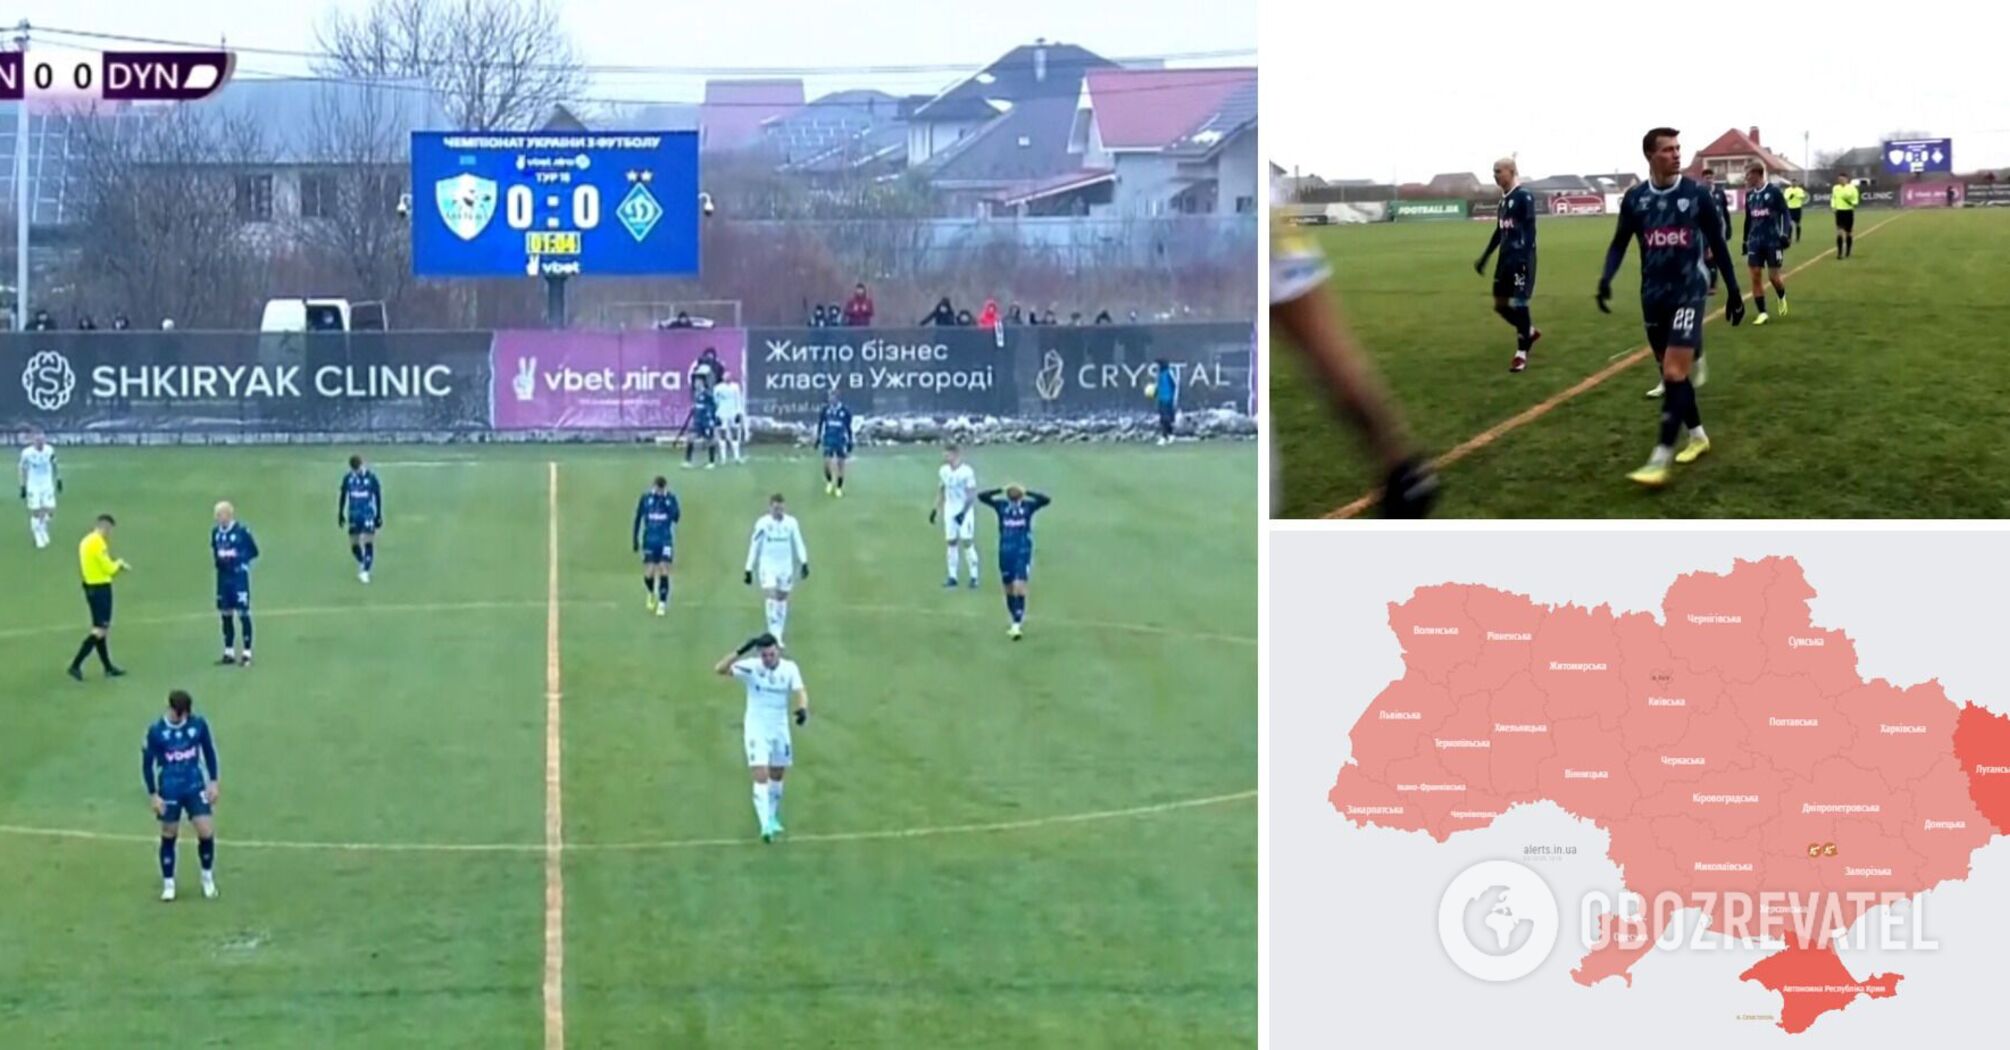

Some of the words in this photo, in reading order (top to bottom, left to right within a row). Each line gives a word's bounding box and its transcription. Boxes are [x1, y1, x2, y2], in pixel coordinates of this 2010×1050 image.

[443, 136, 524, 148] ЧЕМПІОНАТ
[595, 136, 661, 148] ФУТБОЛУ
[507, 184, 533, 229] 0
[573, 184, 599, 229] 0
[1645, 228, 1687, 246] vbet
[542, 261, 580, 273] vbet
[1673, 307, 1695, 330] 22
[765, 340, 854, 362] Житло
[861, 338, 949, 362] бізнес
[92, 364, 301, 397] SHKIRYAK
[315, 364, 452, 397] CLINIC
[544, 366, 615, 391] vbet
[622, 366, 681, 391] ліга
[765, 372, 842, 391] класу
[849, 373, 863, 389] в
[869, 365, 993, 393] Ужгороді
[1413, 625, 1459, 636] Волинська
[1486, 631, 1532, 642] Рівненська
[1788, 636, 1824, 648] Сумська
[1549, 661, 1607, 673] Житомирська
[1379, 710, 1422, 720] Львівська
[1769, 716, 1818, 727] Полтавська
[1880, 723, 1927, 735] Харківська
[1661, 755, 1706, 767] Черкаська
[1564, 768, 1609, 780] Вінницька
[1692, 793, 1759, 804] Кіровоградська
[1346, 804, 1405, 816] Закарпатська
[1802, 802, 1881, 814] Дніпропетровська
[1924, 819, 1966, 831] Донецька
[1523, 844, 1578, 855] alerts.in.ua
[1694, 861, 1753, 872] Миколаївська
[1845, 866, 1892, 878] Запорізька
